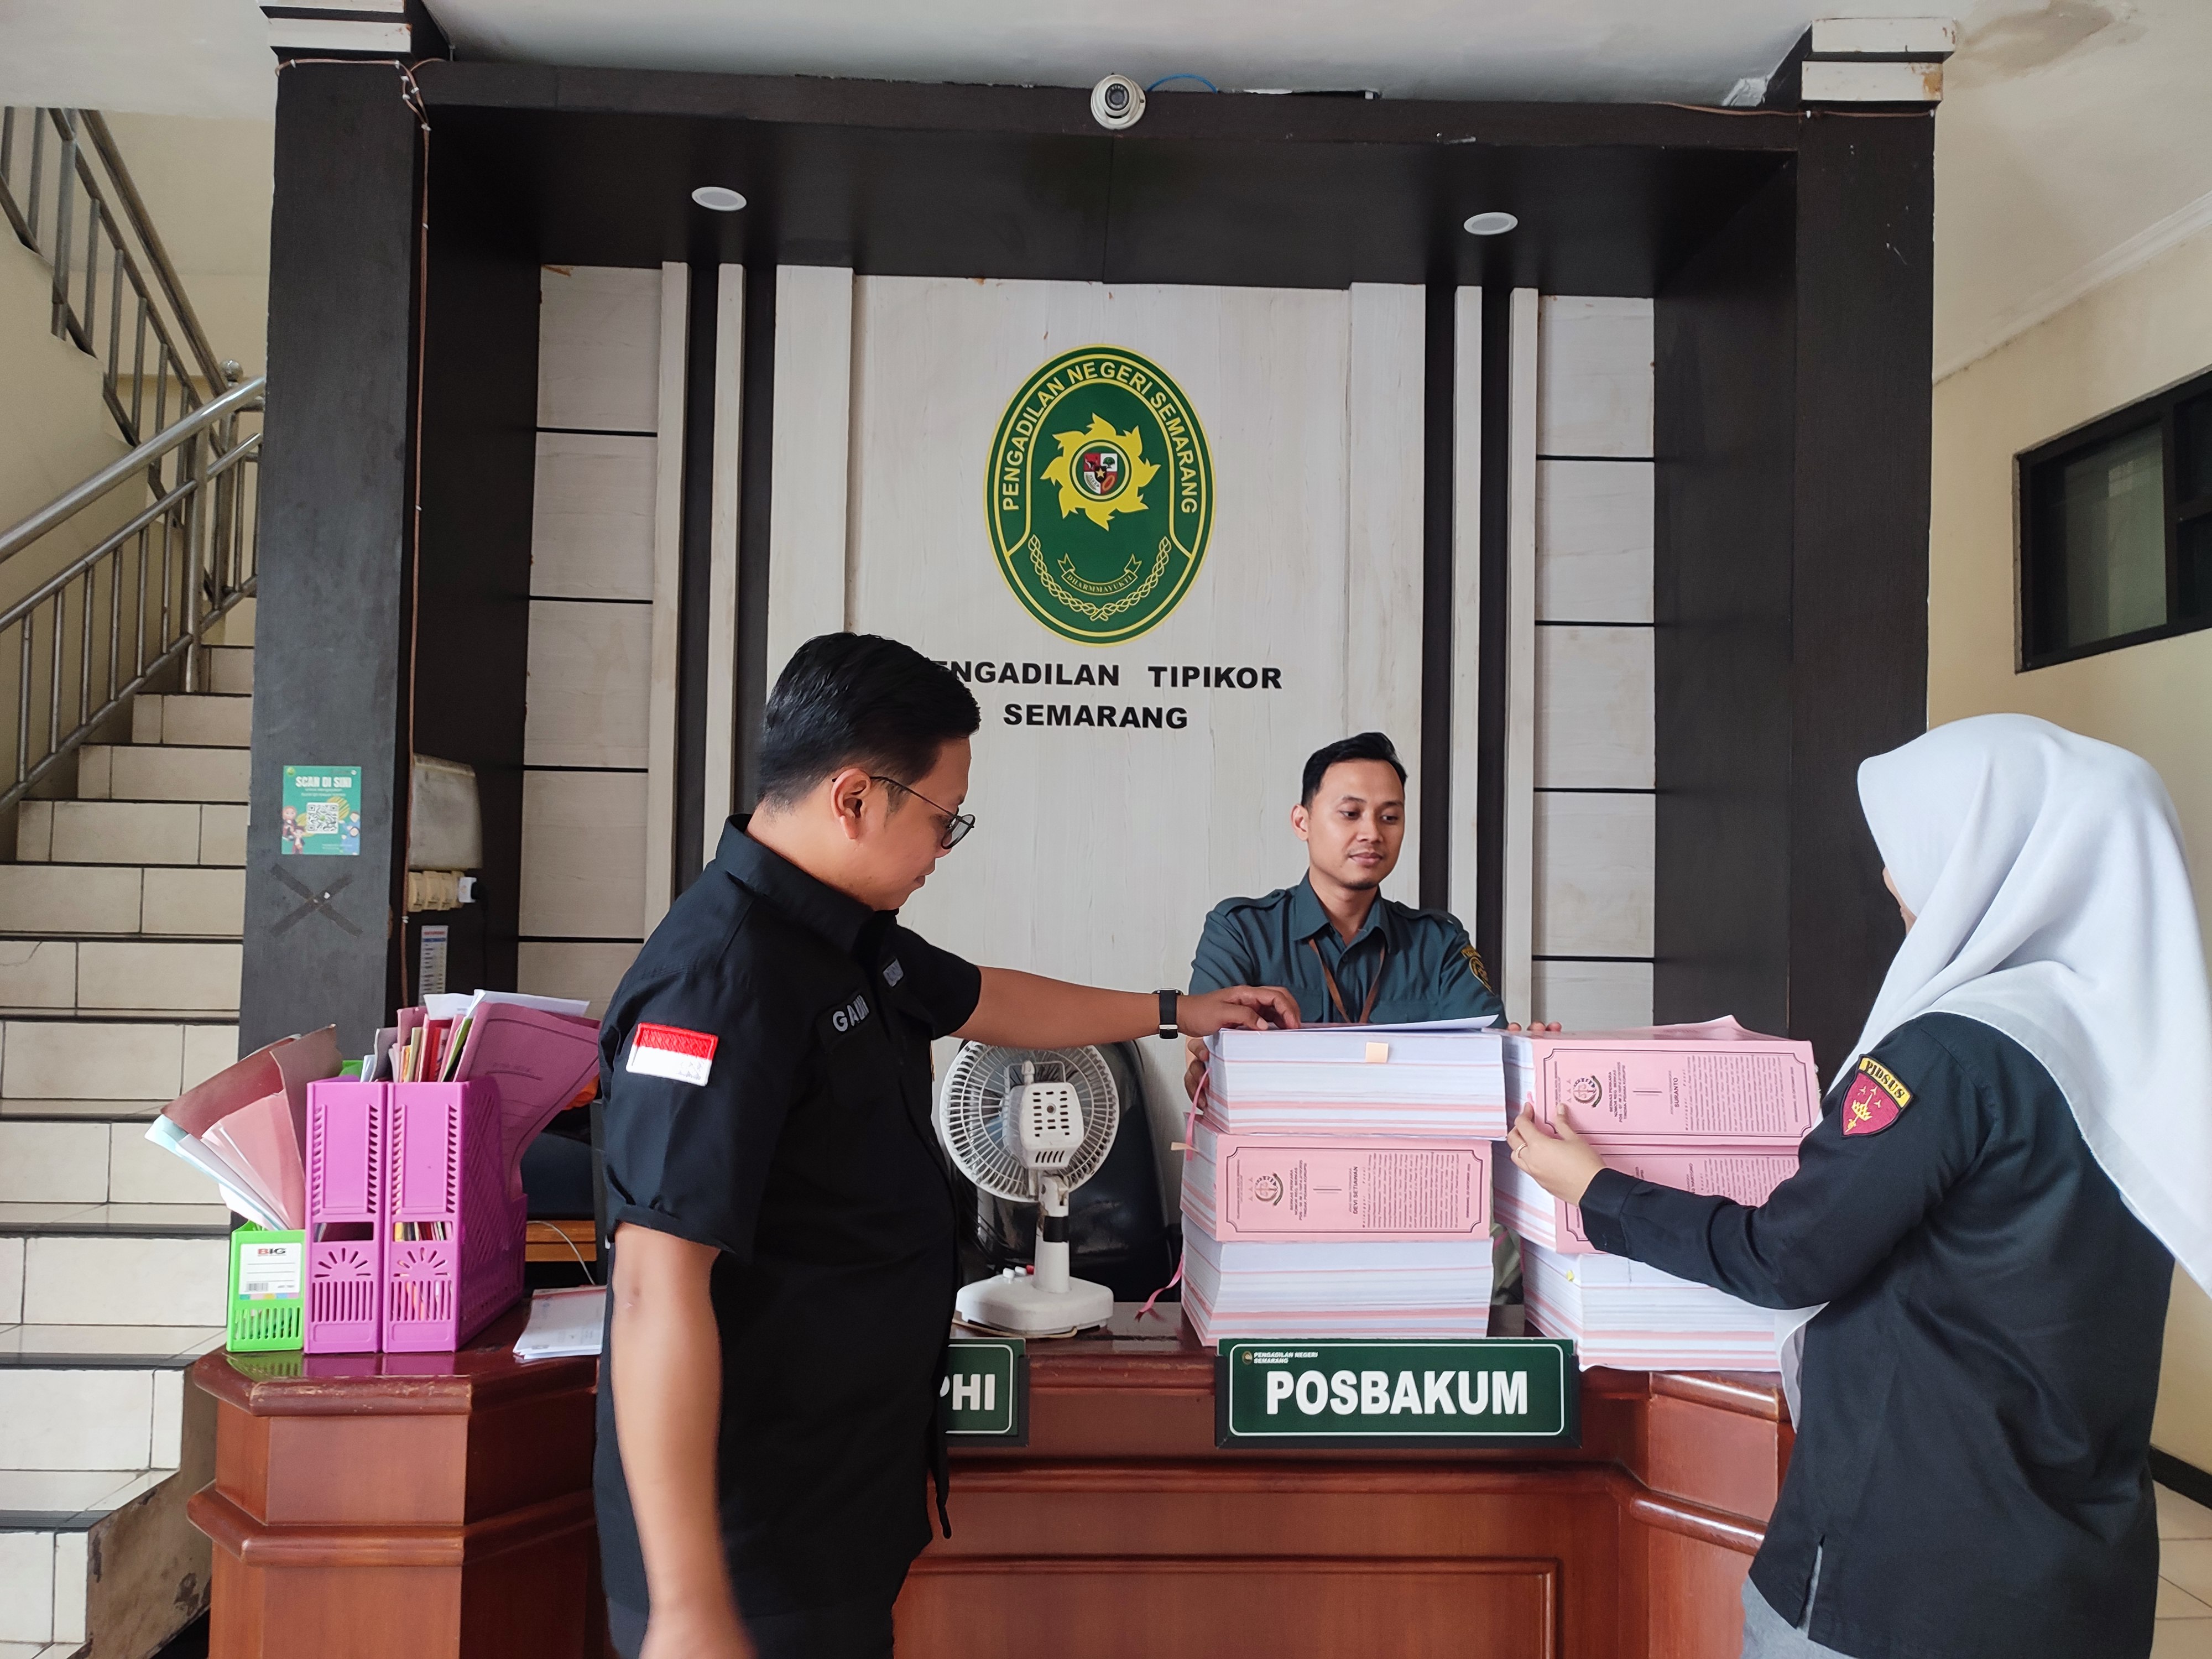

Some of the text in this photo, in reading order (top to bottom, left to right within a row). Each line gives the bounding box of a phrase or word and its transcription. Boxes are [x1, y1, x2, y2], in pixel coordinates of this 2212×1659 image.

[1003, 362, 1198, 513] PENGADILAN NEGERI SEMARANG
[1067, 575, 1132, 592] DHARMMAYUKTI
[931, 660, 1282, 689] NGADILAN TIPIKOR
[1003, 704, 1188, 729] SEMARANG
[295, 776, 320, 787] SCAN
[1864, 1061, 1905, 1098] PIDSUS
[1266, 1370, 1528, 1415] POSBAKUM
